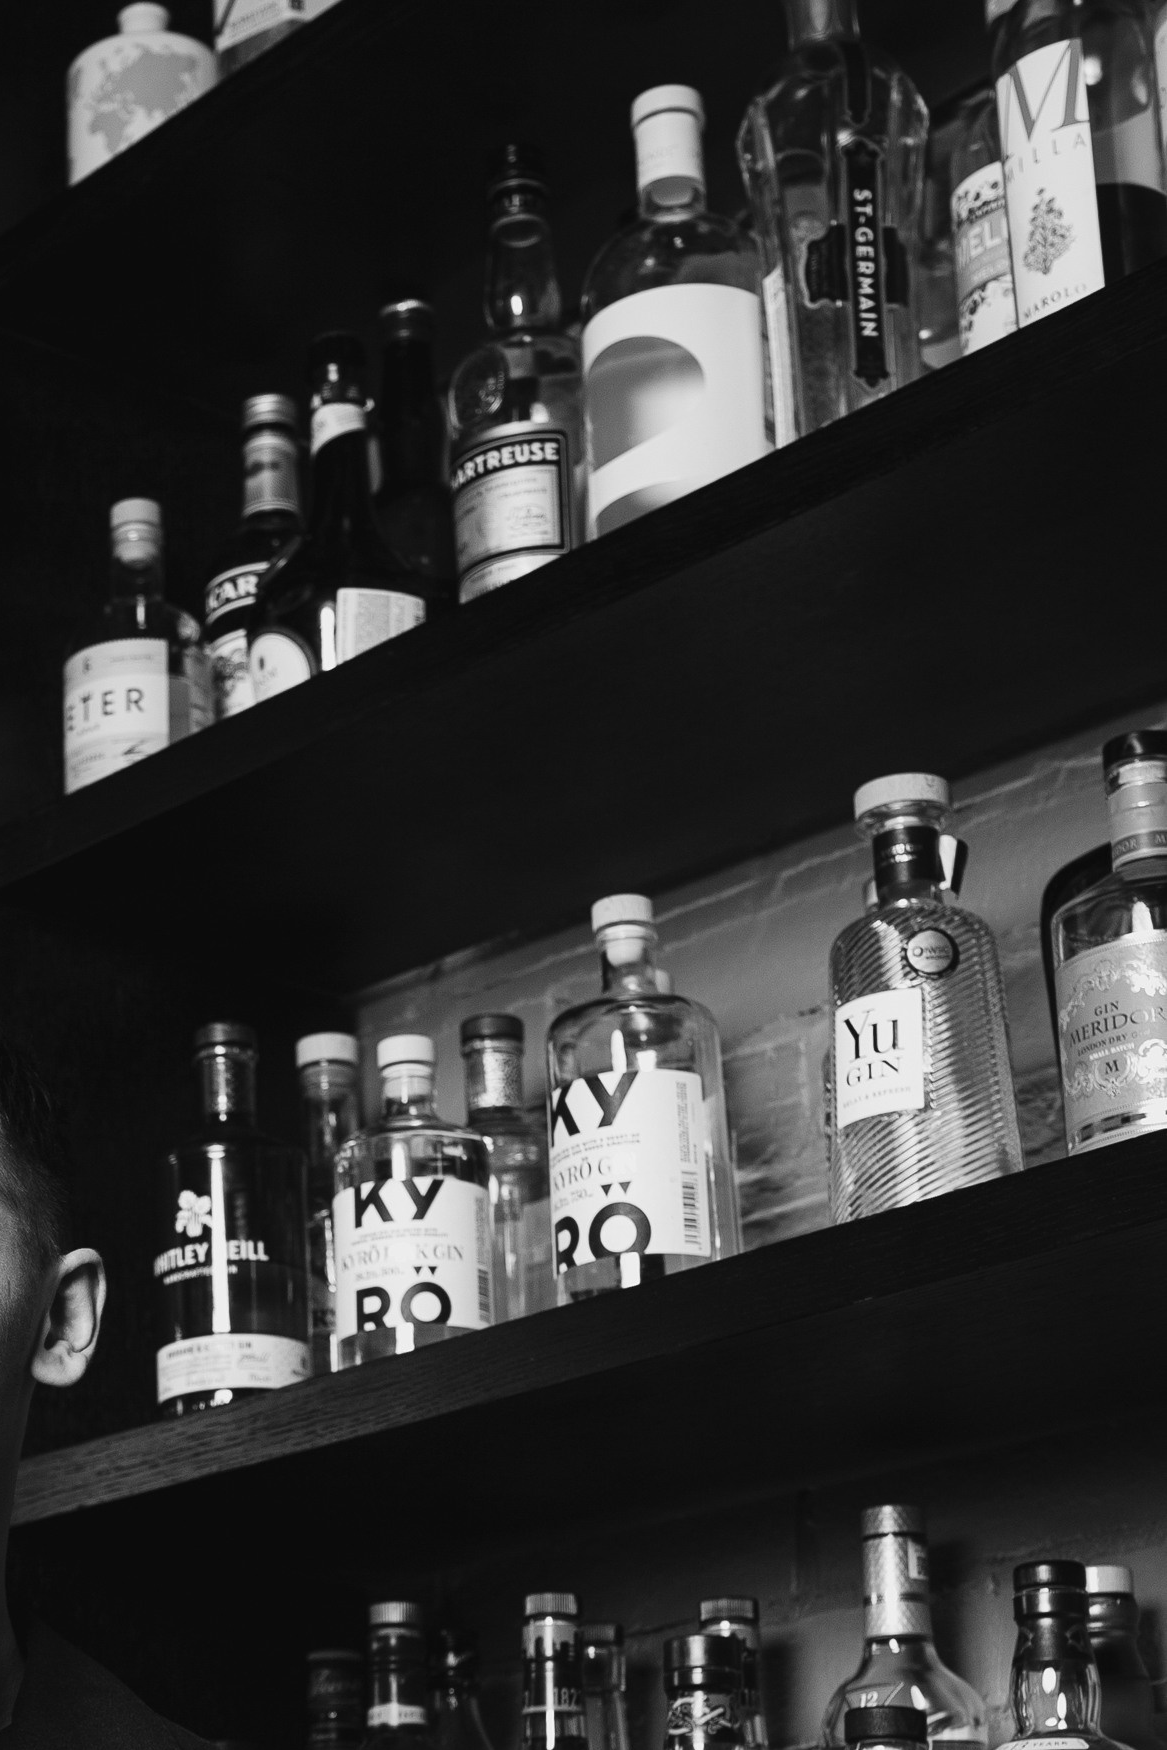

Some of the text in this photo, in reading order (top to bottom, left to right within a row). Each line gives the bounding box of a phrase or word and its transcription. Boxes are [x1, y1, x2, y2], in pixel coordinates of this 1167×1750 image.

[853, 188, 879, 337] ST-GERMAIN
[1093, 1000, 1120, 1017] GIN
[842, 1008, 905, 1063] Yu
[1069, 1006, 1167, 1048] MERIDOR
[1077, 1038, 1107, 1057] LONDON
[1108, 1033, 1128, 1045] DRY
[846, 1057, 903, 1087] GIN
[1104, 1059, 1120, 1076] M
[352, 1179, 444, 1229] KY
[224, 1239, 269, 1261] EILL
[433, 1244, 465, 1261] GIN
[859, 1690, 879, 1708] 12
